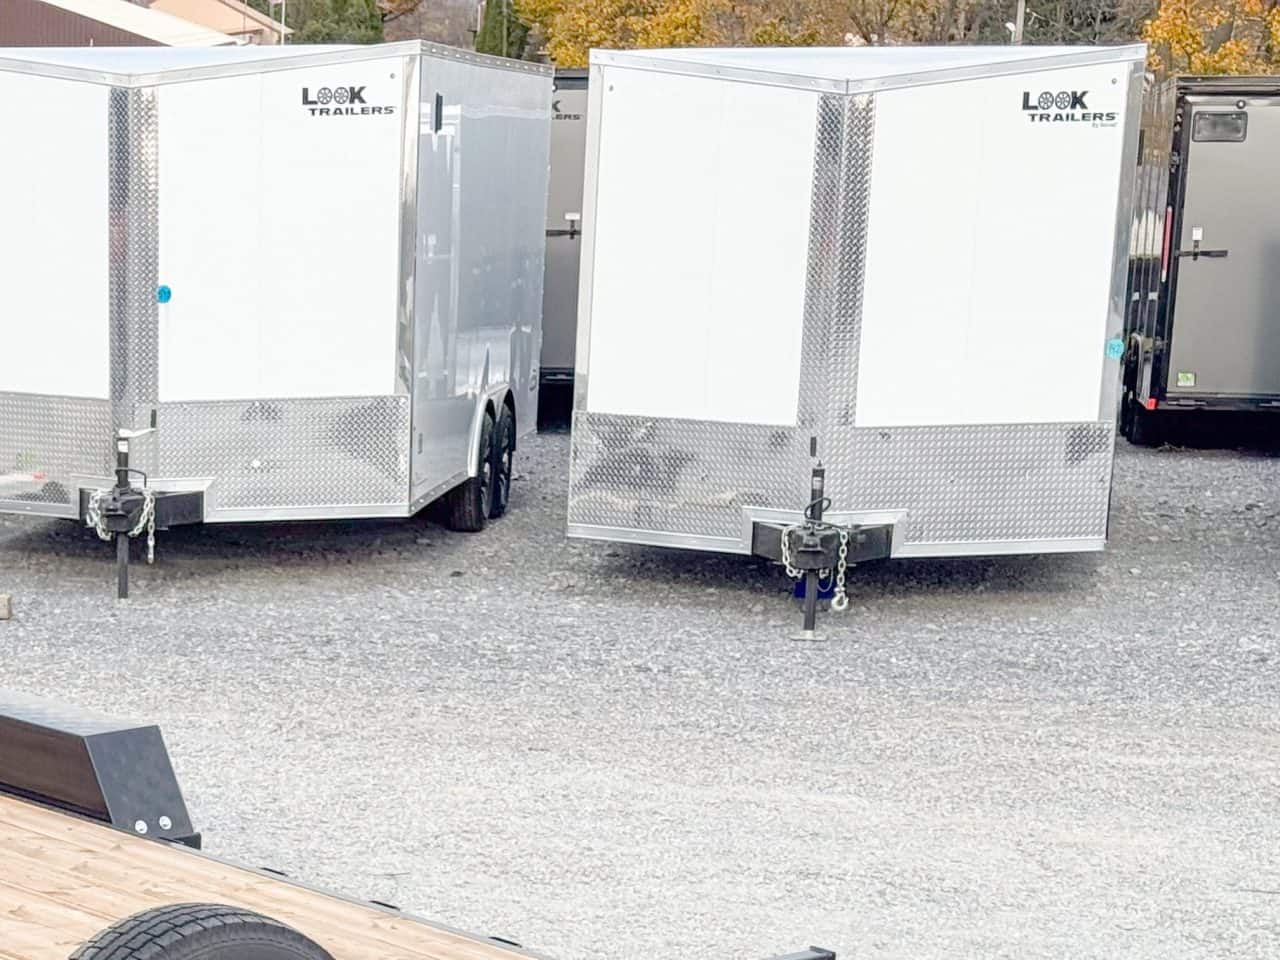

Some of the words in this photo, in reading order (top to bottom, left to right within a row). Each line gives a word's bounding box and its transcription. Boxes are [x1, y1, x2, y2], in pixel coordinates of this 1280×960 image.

[302, 86, 367, 106] LOOK
[1022, 90, 1089, 111] LOOK
[308, 106, 395, 117] TRAILERS
[1027, 112, 1117, 123] TRAILERS
